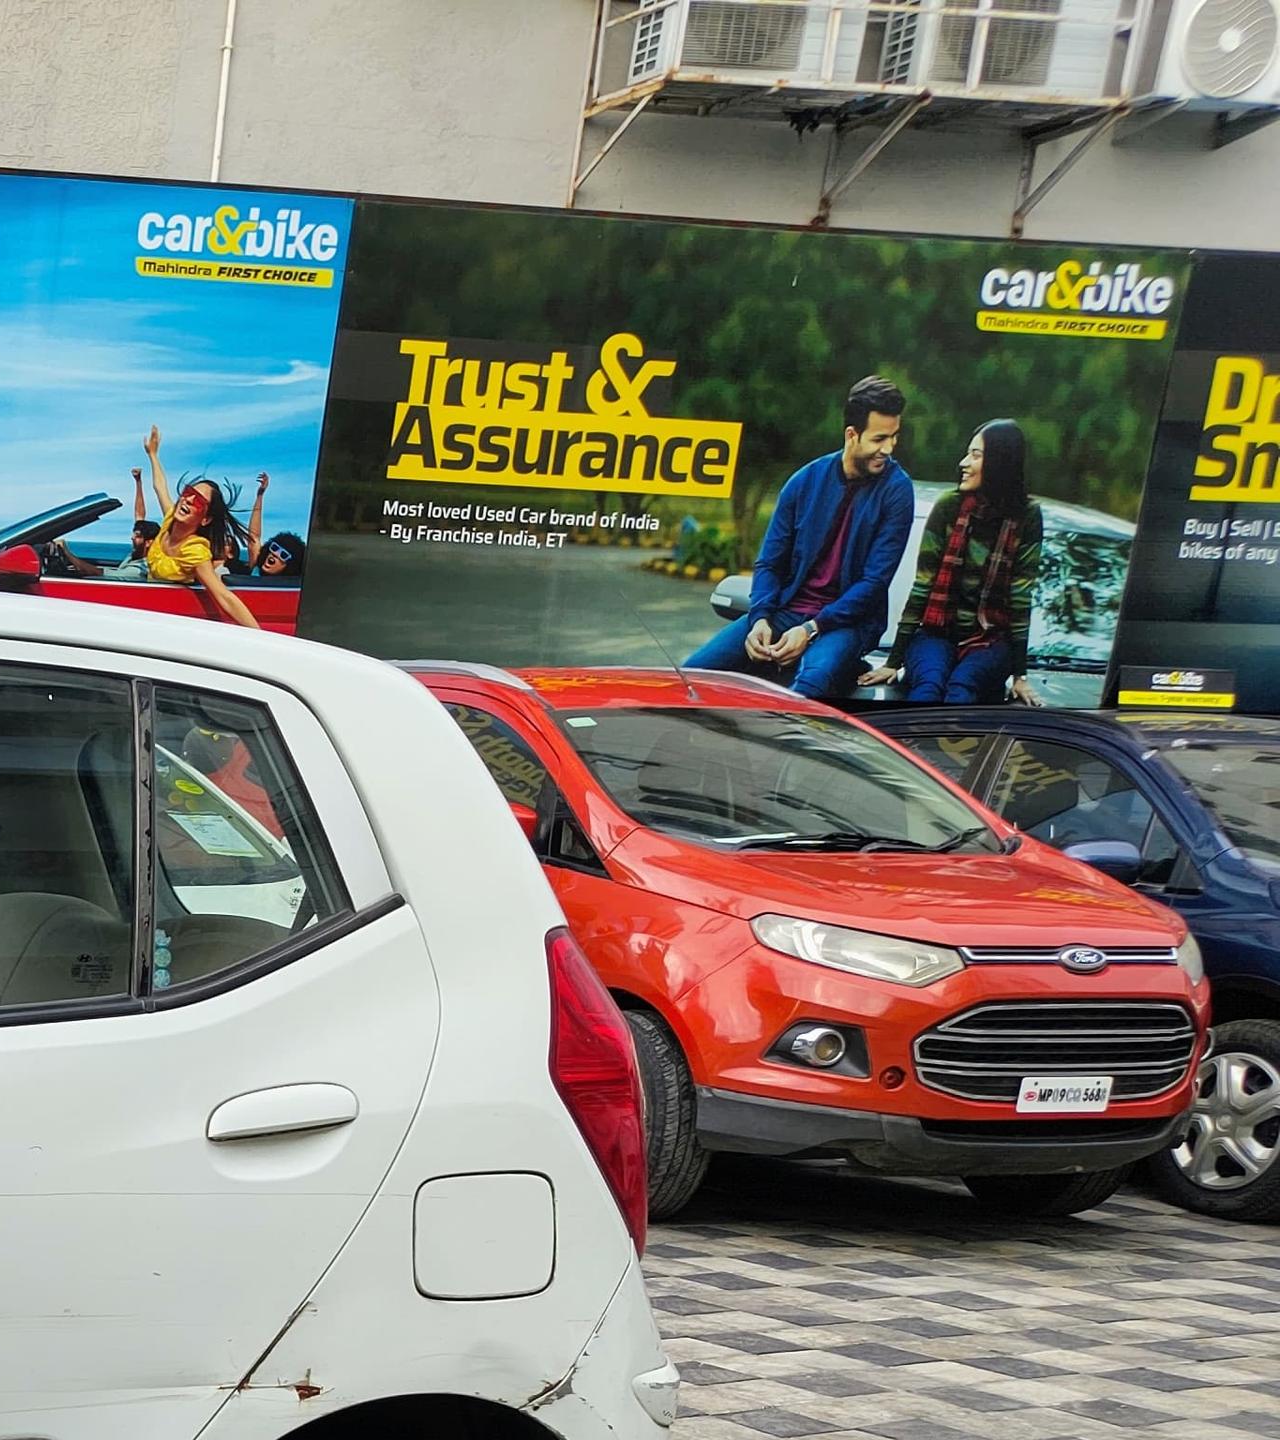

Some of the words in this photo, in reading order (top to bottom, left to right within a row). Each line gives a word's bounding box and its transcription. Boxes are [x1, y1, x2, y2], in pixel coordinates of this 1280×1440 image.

[138, 205, 338, 261] car&bike
[143, 261, 212, 276] Mahindra
[217, 266, 261, 279] FIRST
[263, 269, 317, 283] CHOICE
[981, 259, 1174, 314] car&bike
[984, 316, 1048, 330] Mahindra
[1053, 320, 1096, 332] FIRST
[1098, 322, 1148, 335] CHOICE
[399, 339, 574, 416] Trust
[586, 333, 677, 418] &
[390, 404, 730, 485] Assurance
[382, 500, 424, 518] Most
[427, 502, 471, 520] loved
[475, 506, 515, 523] Used
[519, 507, 546, 524] Car
[549, 509, 596, 528] brand
[599, 512, 618, 528] of
[621, 513, 660, 531] India
[1183, 518, 1219, 539] Buy
[1229, 519, 1264, 537] Sell
[390, 523, 413, 543] By
[416, 525, 494, 545] Franchise
[497, 529, 541, 549] India,
[545, 532, 568, 548] ET
[1178, 541, 1223, 560] bikes
[1224, 542, 1247, 560] of
[1245, 546, 1279, 565] any
